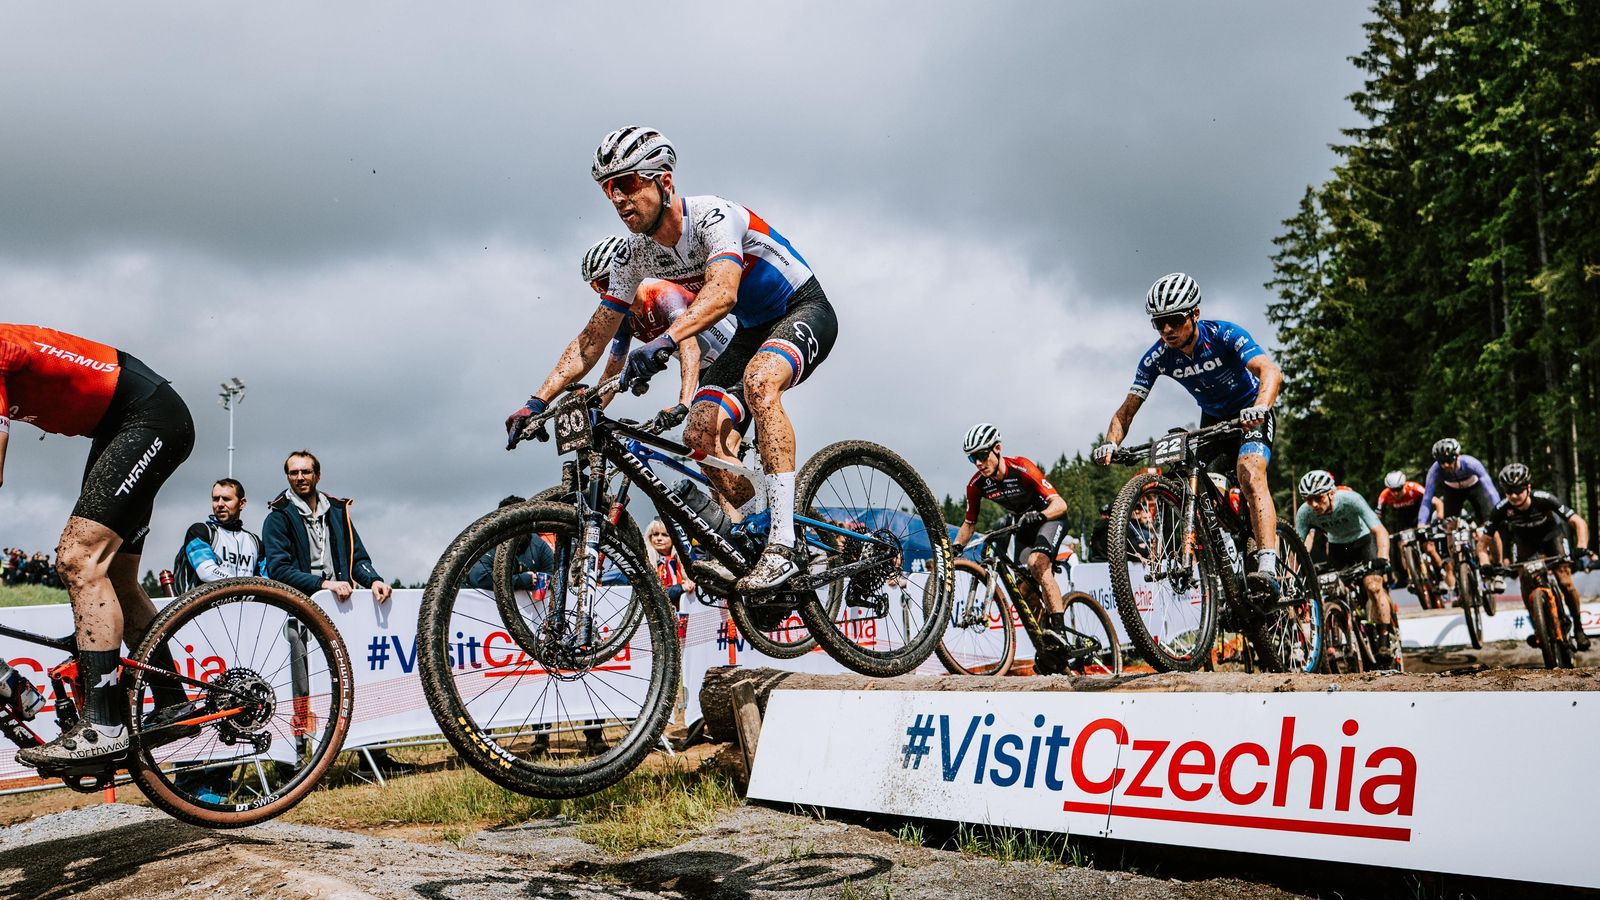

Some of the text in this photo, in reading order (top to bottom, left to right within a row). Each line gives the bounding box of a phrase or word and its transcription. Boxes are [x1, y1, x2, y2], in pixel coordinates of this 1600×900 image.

[1173, 357, 1222, 378] CALOI
[558, 409, 584, 437] 30
[1155, 437, 1182, 456] 22
[600, 543, 636, 576] MAVIC
[934, 543, 945, 580] MAVIC
[941, 538, 952, 592] MAXXIS
[330, 639, 350, 718] SCHWALBE
[458, 716, 512, 769] MAXXIS
[901, 713, 1417, 817] #VisitCzechia
[253, 794, 279, 809] SWISS
